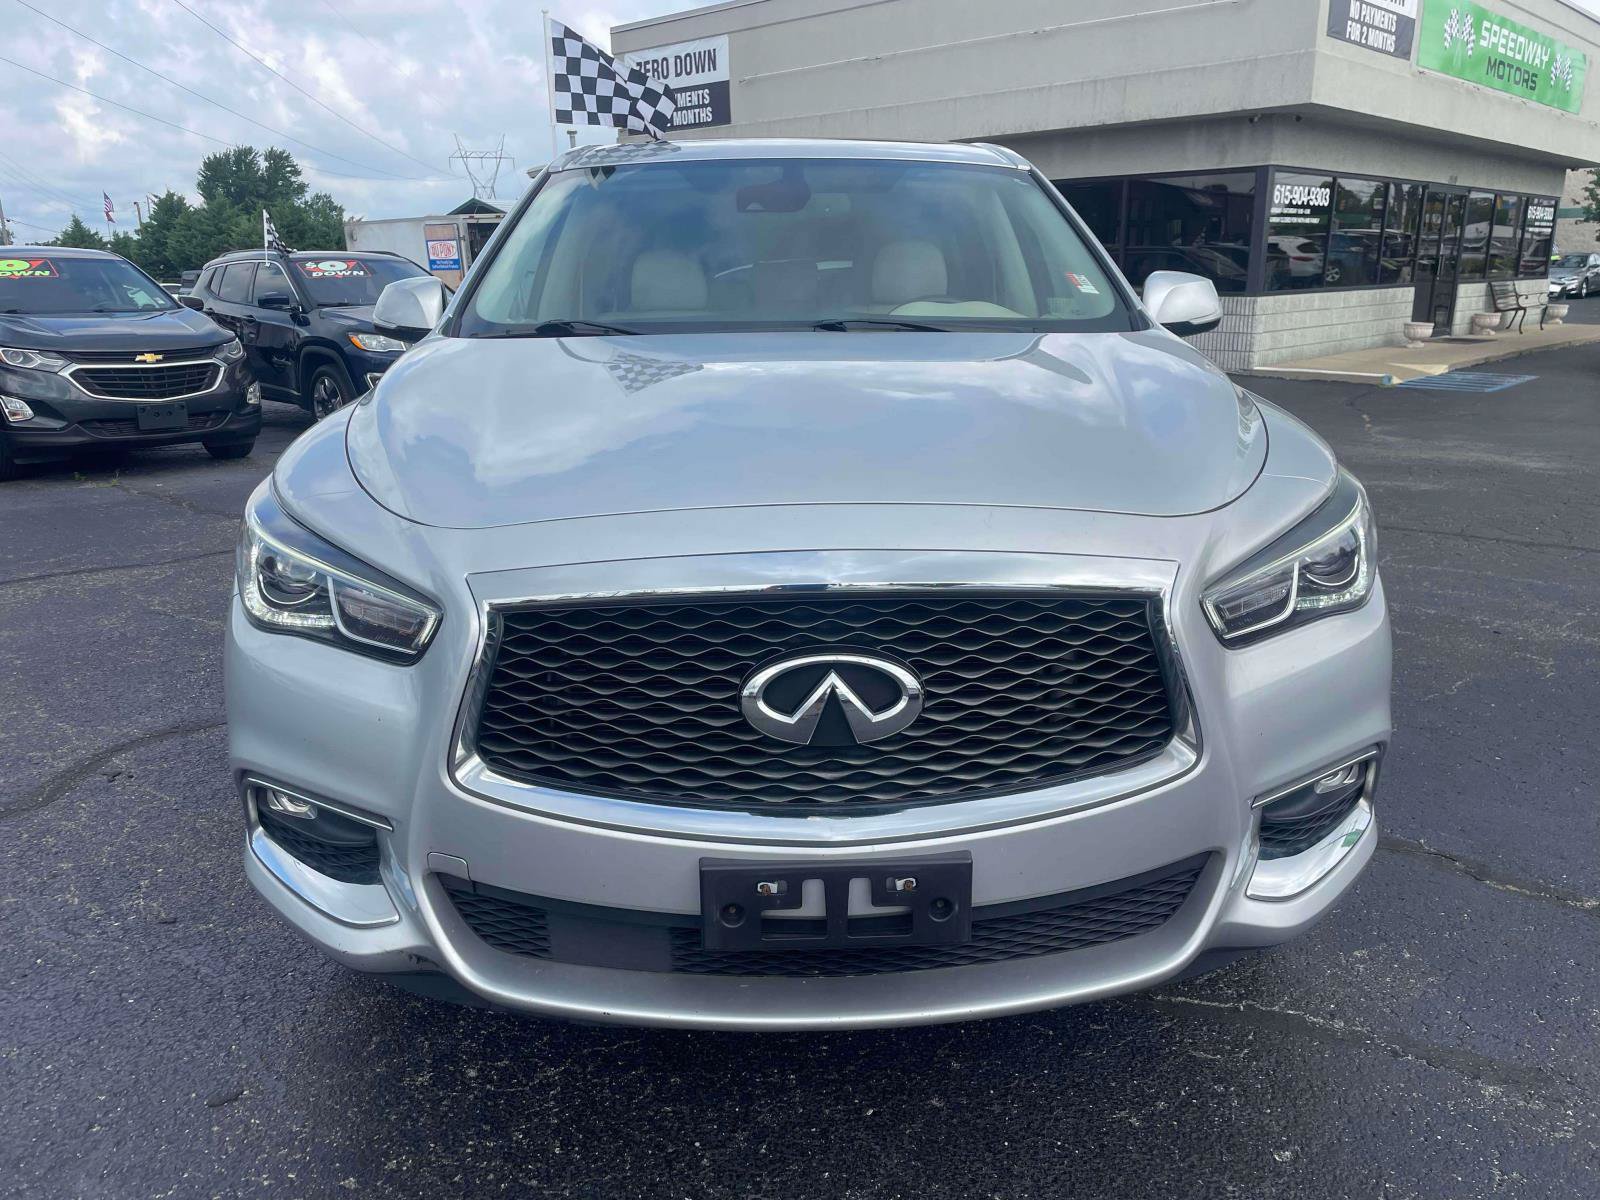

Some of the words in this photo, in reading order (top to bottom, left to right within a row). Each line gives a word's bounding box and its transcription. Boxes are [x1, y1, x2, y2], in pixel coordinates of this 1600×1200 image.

[1360, 4, 1397, 32] PAYMENTS
[1346, 20, 1361, 43] FOR
[1361, 26, 1368, 44] 2
[1367, 28, 1396, 53] MONTHS
[1480, 20, 1551, 70] SPEEDWAY
[674, 48, 717, 78] DOWN
[1486, 56, 1538, 91] MOTORS
[675, 89, 711, 108] MENTS
[673, 107, 713, 126] MONTHS
[1273, 184, 1330, 207] 615-904-9303
